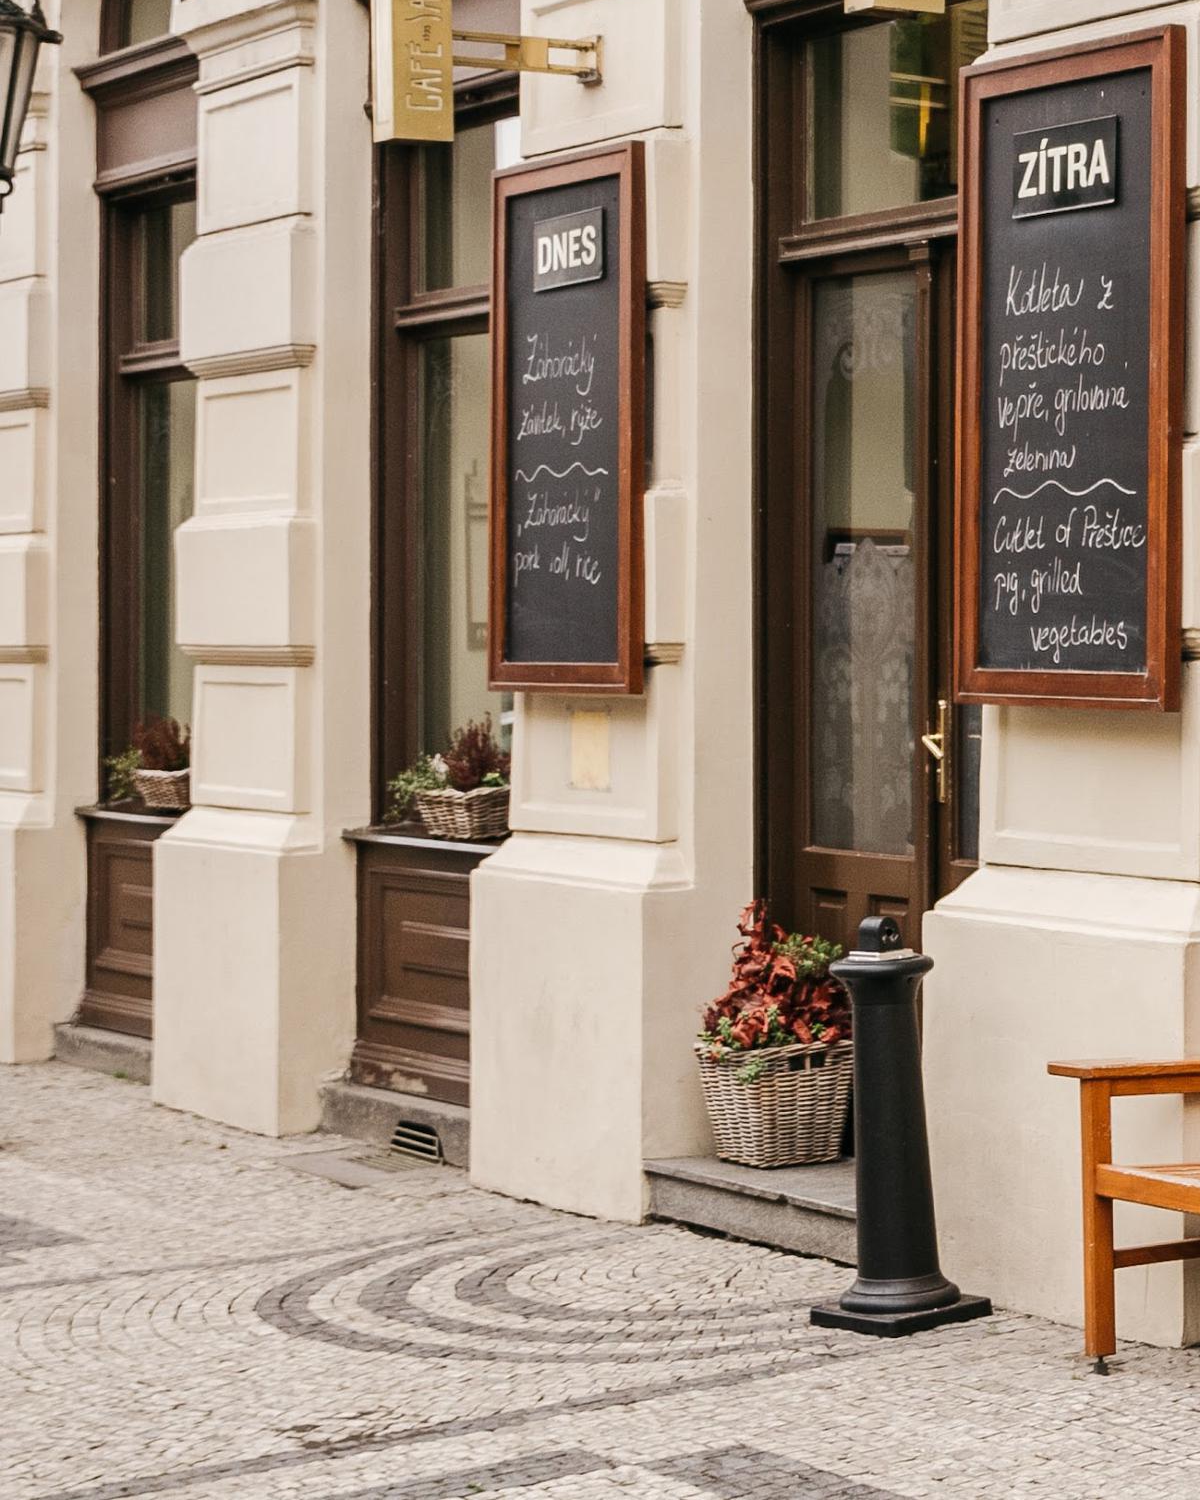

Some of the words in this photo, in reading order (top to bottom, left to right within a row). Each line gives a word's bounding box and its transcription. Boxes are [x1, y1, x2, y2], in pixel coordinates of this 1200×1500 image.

[406, 39, 443, 112] CAFÉ
[1018, 138, 1110, 199] ZÍTRA
[537, 224, 596, 275] DNES
[1005, 262, 1084, 316] Kotleta
[999, 326, 1105, 387] přeštického
[998, 382, 1049, 442] vepře,
[1003, 441, 1076, 478] zelenina
[993, 515, 1046, 553] Cutlet
[1055, 507, 1078, 548] of
[576, 550, 602, 586] rice
[993, 561, 1026, 616] pig,
[1030, 555, 1083, 614] grilled
[1030, 614, 1128, 664] vegetables
